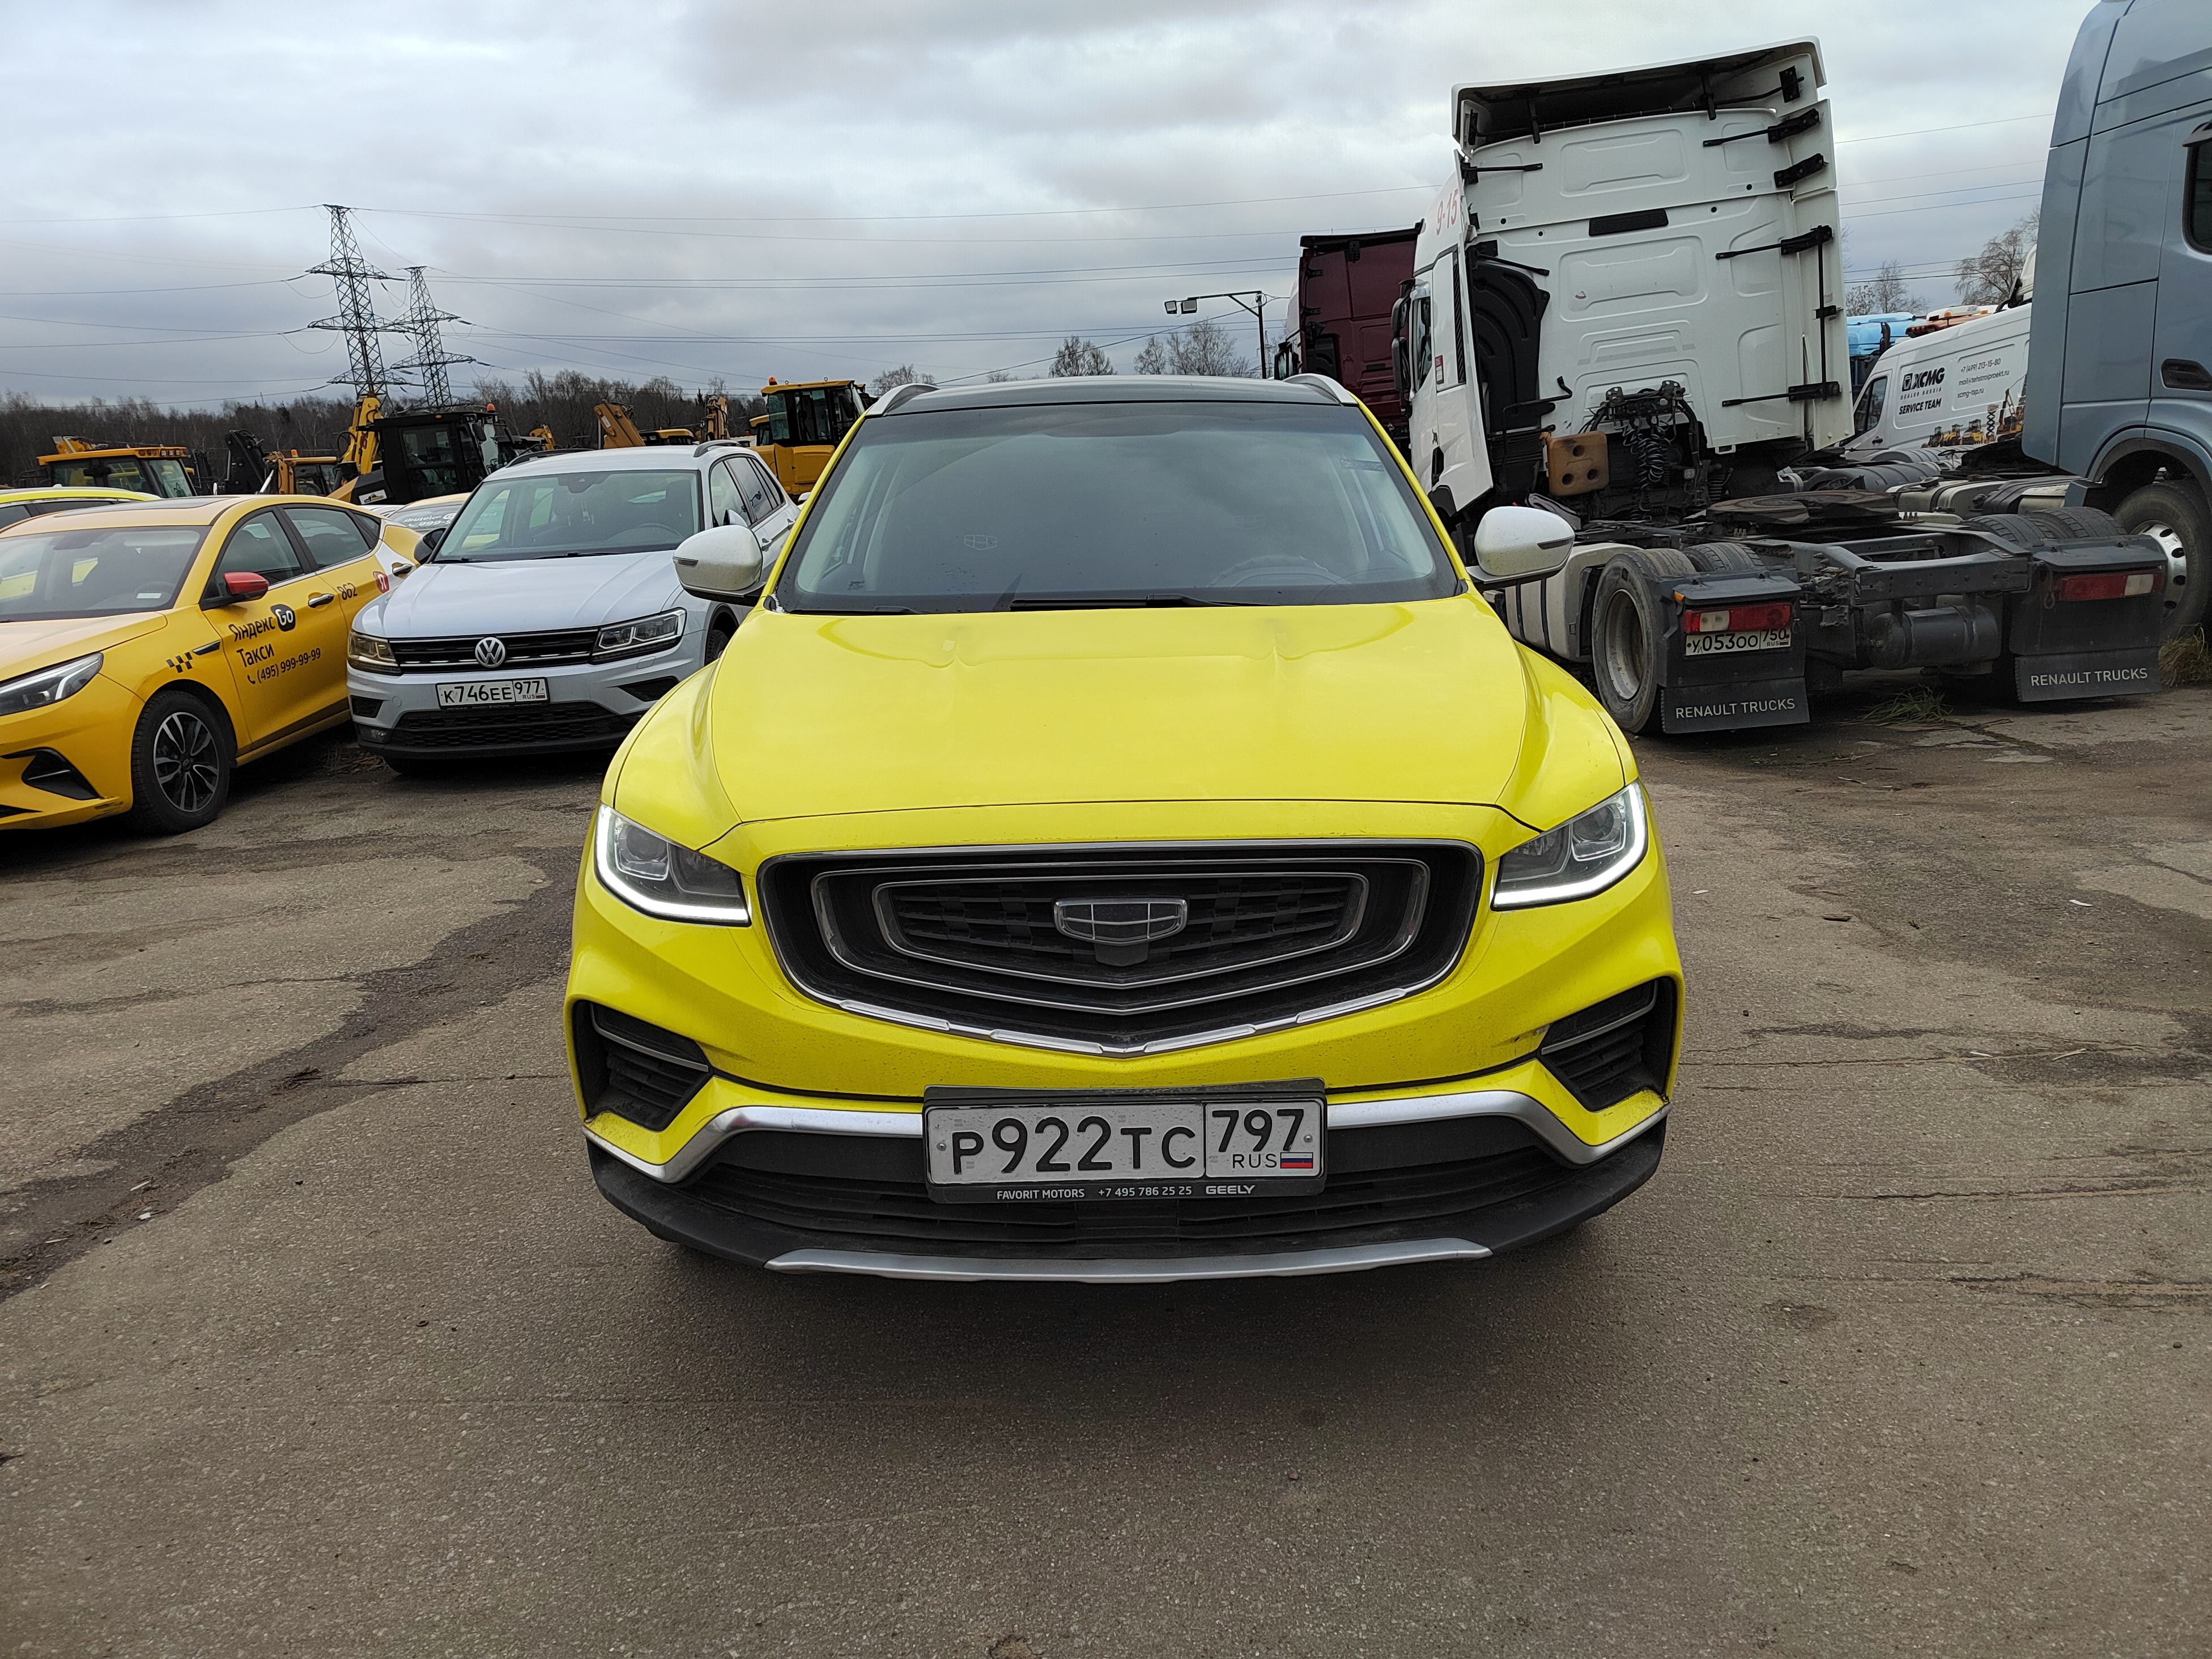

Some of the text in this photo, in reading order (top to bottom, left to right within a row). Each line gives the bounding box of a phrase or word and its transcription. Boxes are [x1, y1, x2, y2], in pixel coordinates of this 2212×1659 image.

[1436, 189, 1458, 235] 9-15
[1966, 363, 1977, 373] (499)
[1977, 358, 2001, 370] 213-15-80
[1911, 367, 1945, 390] XCMG
[1922, 386, 1942, 395] RUSSIA
[1899, 398, 1942, 415] SERVICE TEAM
[337, 582, 358, 600] 862
[228, 609, 293, 642] Яндекс Go
[236, 643, 275, 667] Такси
[257, 648, 321, 683] (495) 999-99-99
[2031, 667, 2148, 687] RENAULT TRUCKS
[514, 680, 540, 695] 977
[1675, 698, 1796, 719] RENAULT TRUCKS
[1211, 1108, 1304, 1152] 797
[1232, 1153, 1277, 1168] RUS
[997, 1185, 1256, 1200] FAVORIT MOTORS +7 495 786 25 25 GEELY
